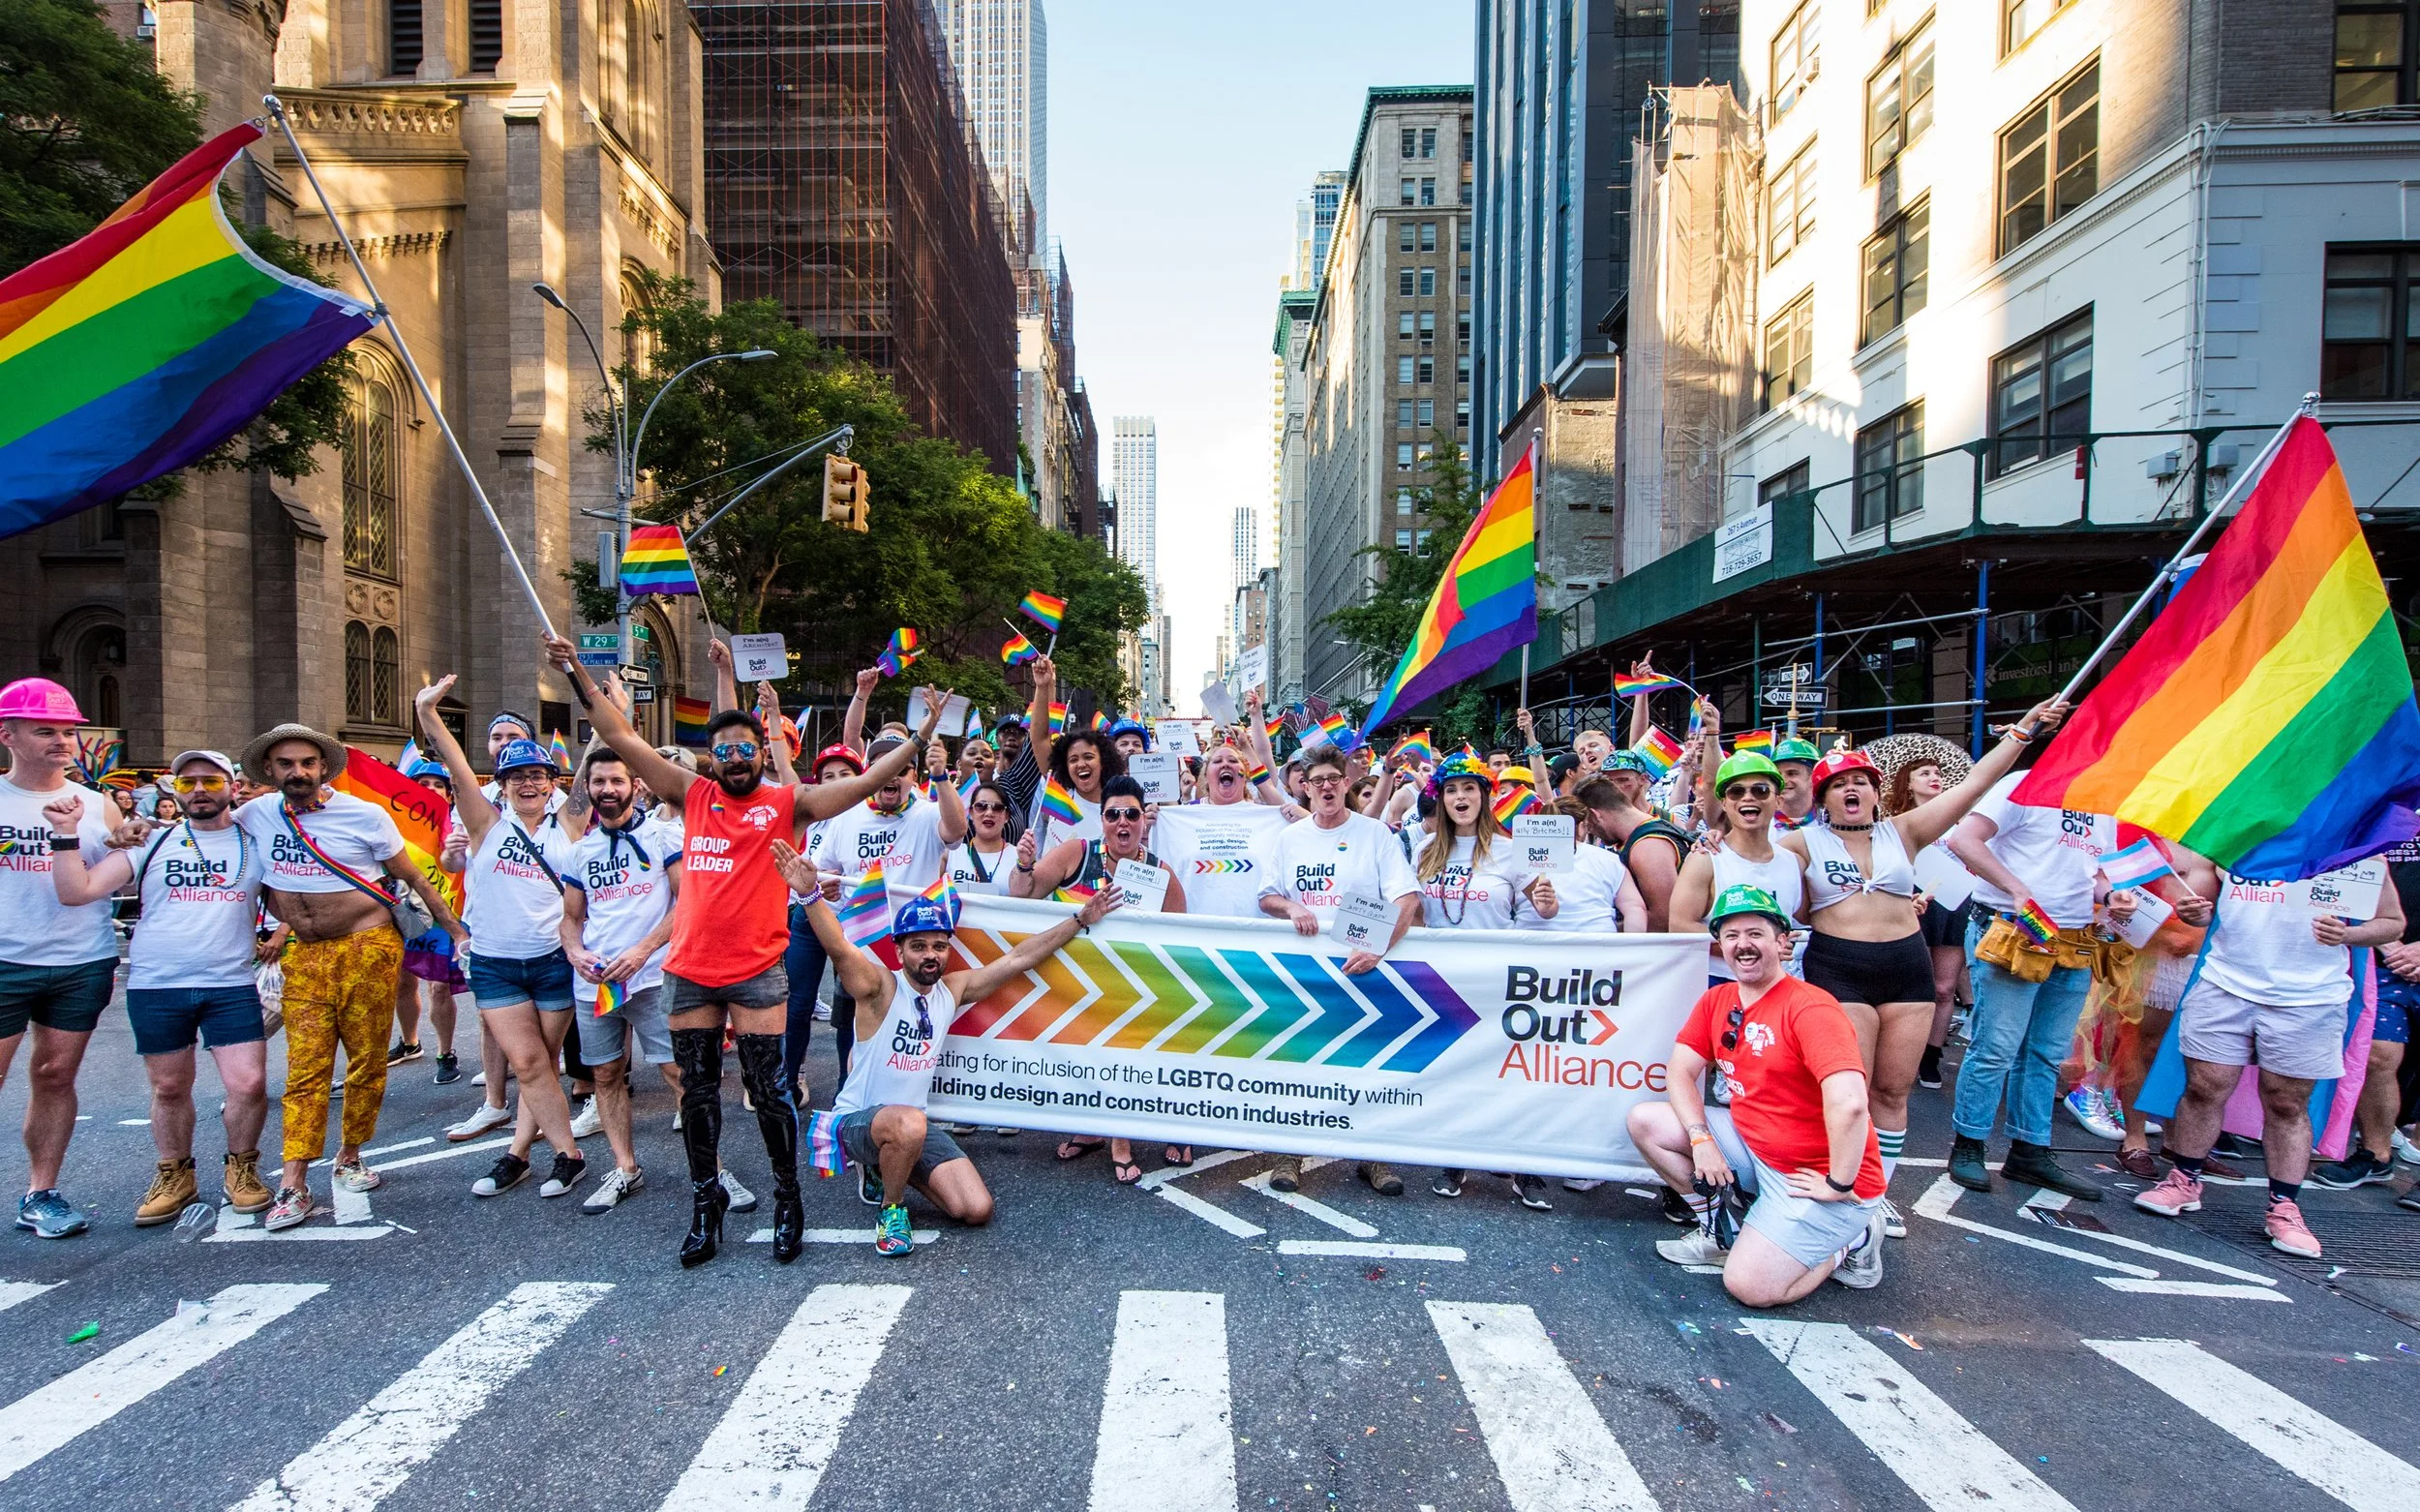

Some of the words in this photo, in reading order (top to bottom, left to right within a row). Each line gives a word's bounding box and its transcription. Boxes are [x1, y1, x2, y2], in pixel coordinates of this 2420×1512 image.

[634, 625, 639, 637] 5
[583, 636, 591, 647] W
[594, 636, 608, 647] 29
[623, 669, 632, 679] ONE
[636, 670, 646, 680] WAY
[1770, 692, 1791, 701] ONE
[1797, 692, 1818, 701] WAY
[2062, 809, 2095, 827] Build
[2061, 819, 2084, 836] Ou
[690, 835, 731, 855] GROUP
[859, 830, 897, 846] Build
[2058, 832, 2103, 858] Alliance
[271, 848, 308, 864] Out
[497, 847, 532, 866] Out
[858, 845, 887, 859] Out
[166, 860, 227, 873] Build
[272, 862, 334, 877] Allianc
[588, 854, 629, 876] Build
[686, 855, 734, 873] LEADER
[1130, 863, 1141, 872] I'm
[1142, 868, 1155, 877] a(n)
[1296, 862, 1336, 879] Build
[1442, 865, 1472, 876] uild
[1528, 861, 1558, 869] Alliance
[1824, 861, 1860, 873] Bui
[165, 873, 210, 888] Out
[589, 872, 622, 890] Out
[1296, 877, 1324, 892] Out
[166, 888, 247, 902] Alliance
[593, 882, 652, 903] Alliance
[1124, 890, 1142, 900] Build
[1425, 885, 1489, 902] Alliance
[2131, 887, 2143, 898] I'm
[2142, 895, 2157, 907] a(n)
[2229, 885, 2285, 904] Allian
[2310, 893, 2331, 902] Out
[2311, 886, 2341, 897] Build
[1123, 896, 1135, 905] Out
[1355, 896, 1368, 906] I'm
[1369, 901, 1384, 911] a(n)
[2308, 900, 2351, 912] Alliance
[1346, 929, 1361, 939] Out
[1348, 922, 1369, 934] Build
[1345, 935, 1373, 949] Alliance
[1504, 965, 1623, 1007] Build
[1500, 1003, 1588, 1045] Out
[892, 1036, 923, 1056] Out
[1497, 1043, 1668, 1093] Alliance
[936, 1049, 979, 1073] ating
[983, 1053, 1009, 1072] for
[1012, 1057, 1095, 1080] inclusion
[1099, 1064, 1119, 1082] of
[1123, 1066, 1153, 1085] the
[1157, 1067, 1234, 1092] LGBTQ
[1237, 1077, 1361, 1106] community
[1365, 1086, 1424, 1107] within
[929, 1075, 986, 1101] ilding
[989, 1081, 1059, 1106] design
[1062, 1090, 1102, 1108] and
[1104, 1094, 1239, 1121] construction
[1242, 1104, 1354, 1131] industries.
